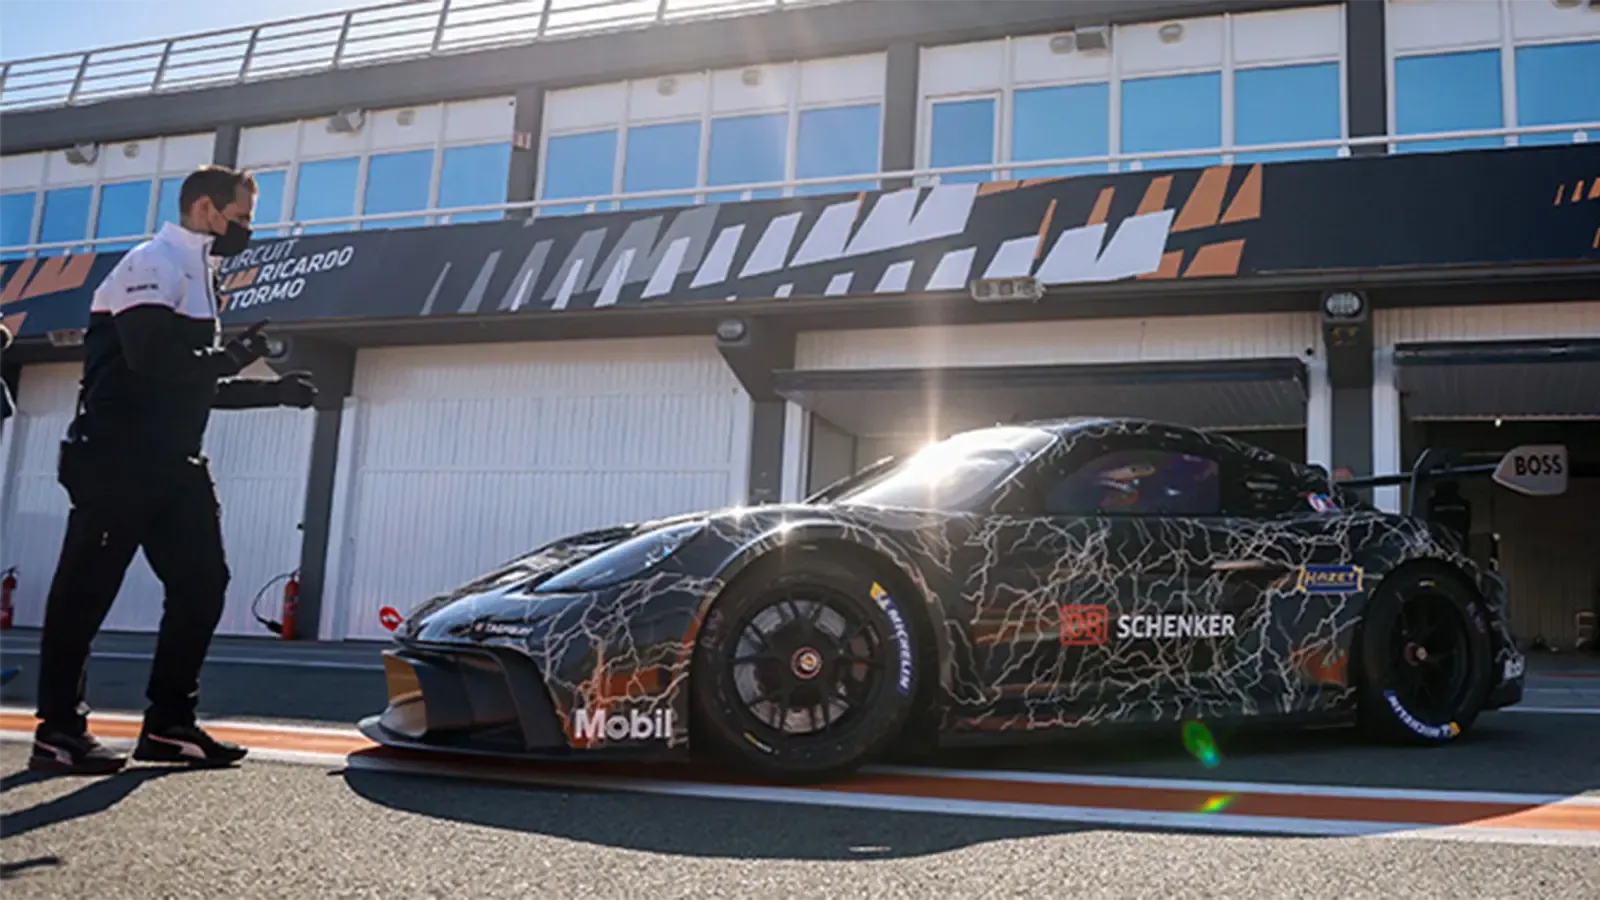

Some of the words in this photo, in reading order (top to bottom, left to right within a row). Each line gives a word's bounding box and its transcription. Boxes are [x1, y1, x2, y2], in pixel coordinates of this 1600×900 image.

[221, 238, 299, 272] CIRCUIT
[257, 246, 354, 283] RICARDO
[230, 278, 305, 311] TORMO
[1514, 455, 1563, 476] BOSS
[1066, 611, 1102, 638] DB
[1116, 614, 1236, 639] SCHENKER
[888, 609, 912, 689] MICHELIN
[574, 708, 673, 740] Mobil
